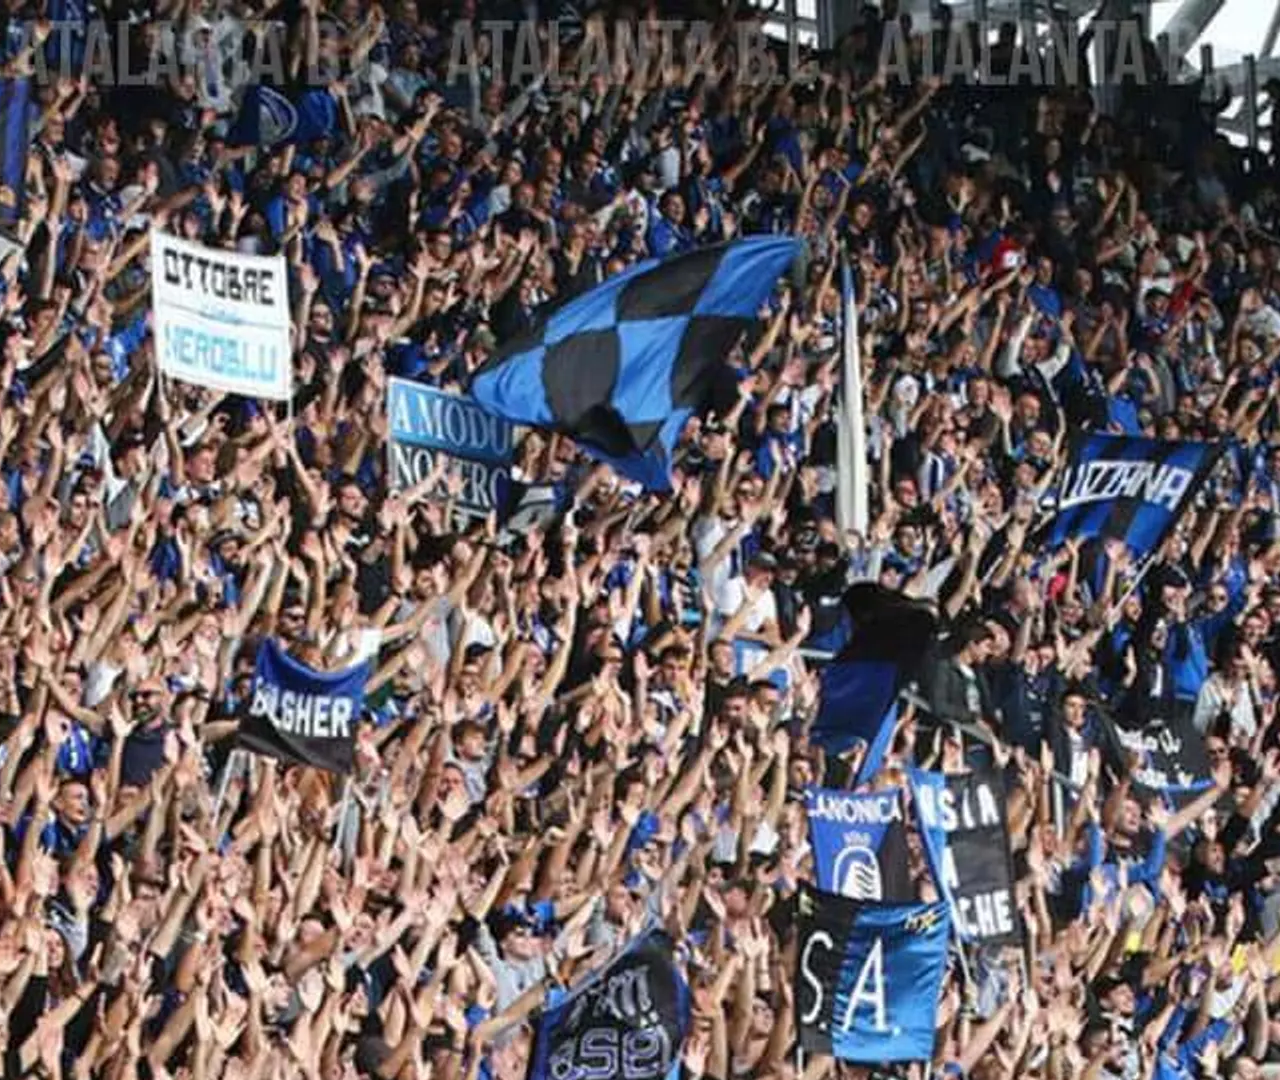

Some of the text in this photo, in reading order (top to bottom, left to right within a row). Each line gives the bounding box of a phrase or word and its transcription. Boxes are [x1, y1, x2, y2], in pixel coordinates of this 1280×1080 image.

[164, 247, 275, 306] OTTOBRE
[165, 319, 277, 384] NEROBLU
[393, 390, 412, 434] A
[1059, 460, 1193, 511] LUZZANA
